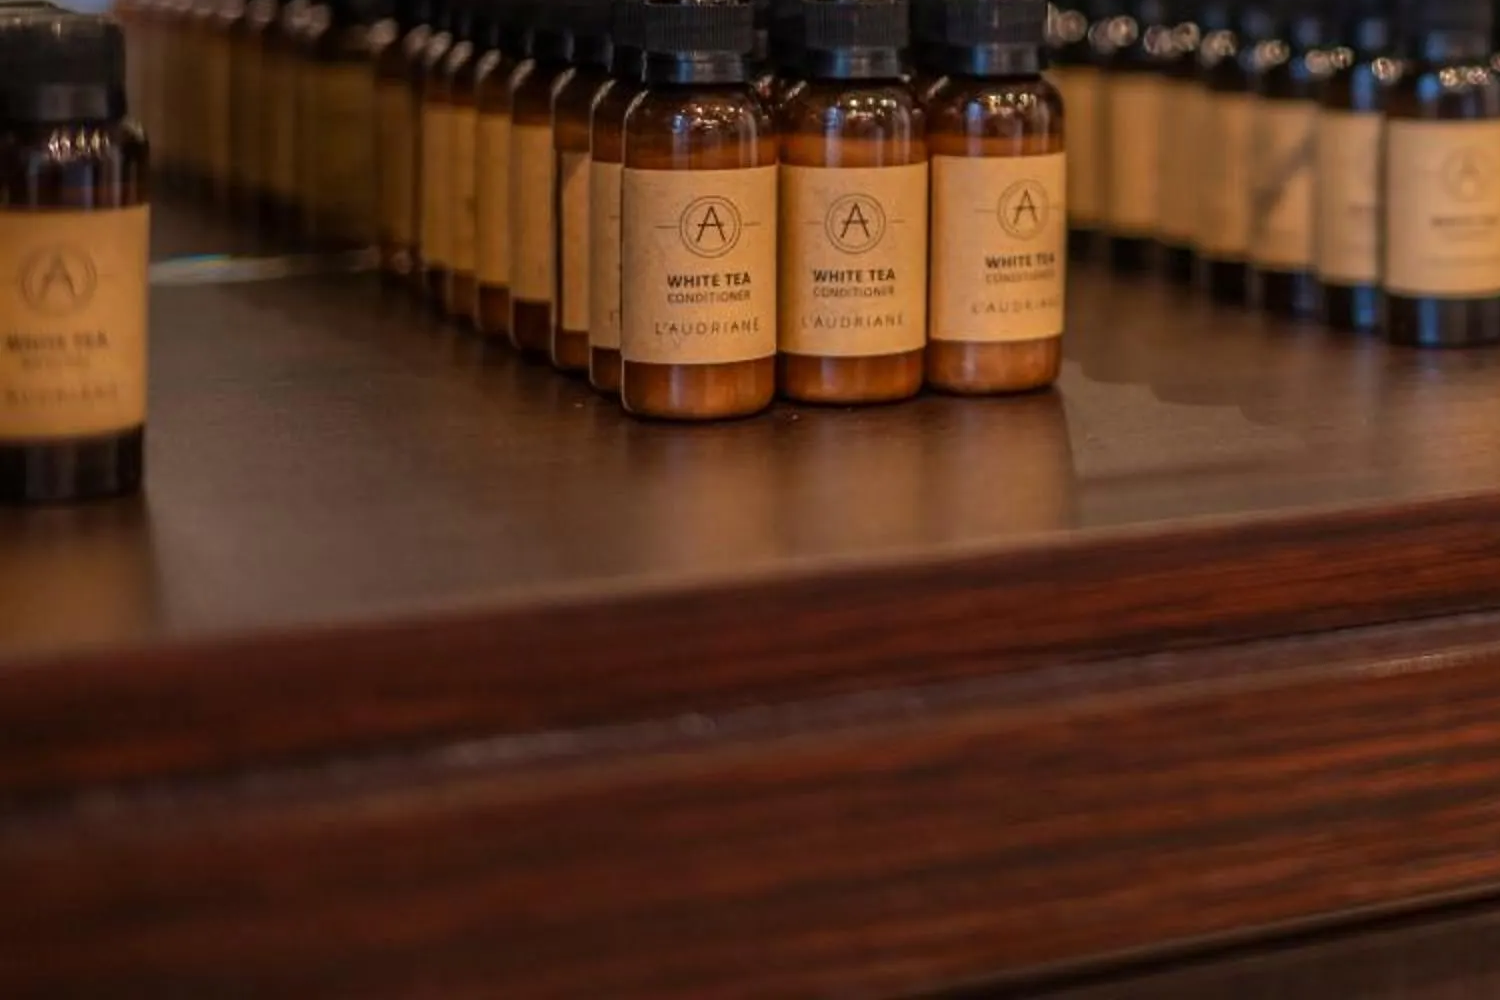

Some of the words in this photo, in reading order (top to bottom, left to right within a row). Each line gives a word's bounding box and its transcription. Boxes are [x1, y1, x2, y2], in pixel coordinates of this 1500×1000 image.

[1012, 188, 1039, 225] A
[695, 205, 727, 243] A
[839, 201, 871, 239] A
[984, 254, 1032, 269] WHITE
[1035, 252, 1055, 266] TEA
[666, 273, 721, 289] WHITE
[724, 271, 752, 286] TEA
[812, 269, 862, 284] WHITE
[869, 267, 896, 282] TEA
[666, 289, 751, 305] CONDITIONER
[812, 284, 895, 299] CONDITIONER
[654, 316, 760, 336] L'AUDRIANE
[801, 312, 904, 330] L'AUDRIANE
